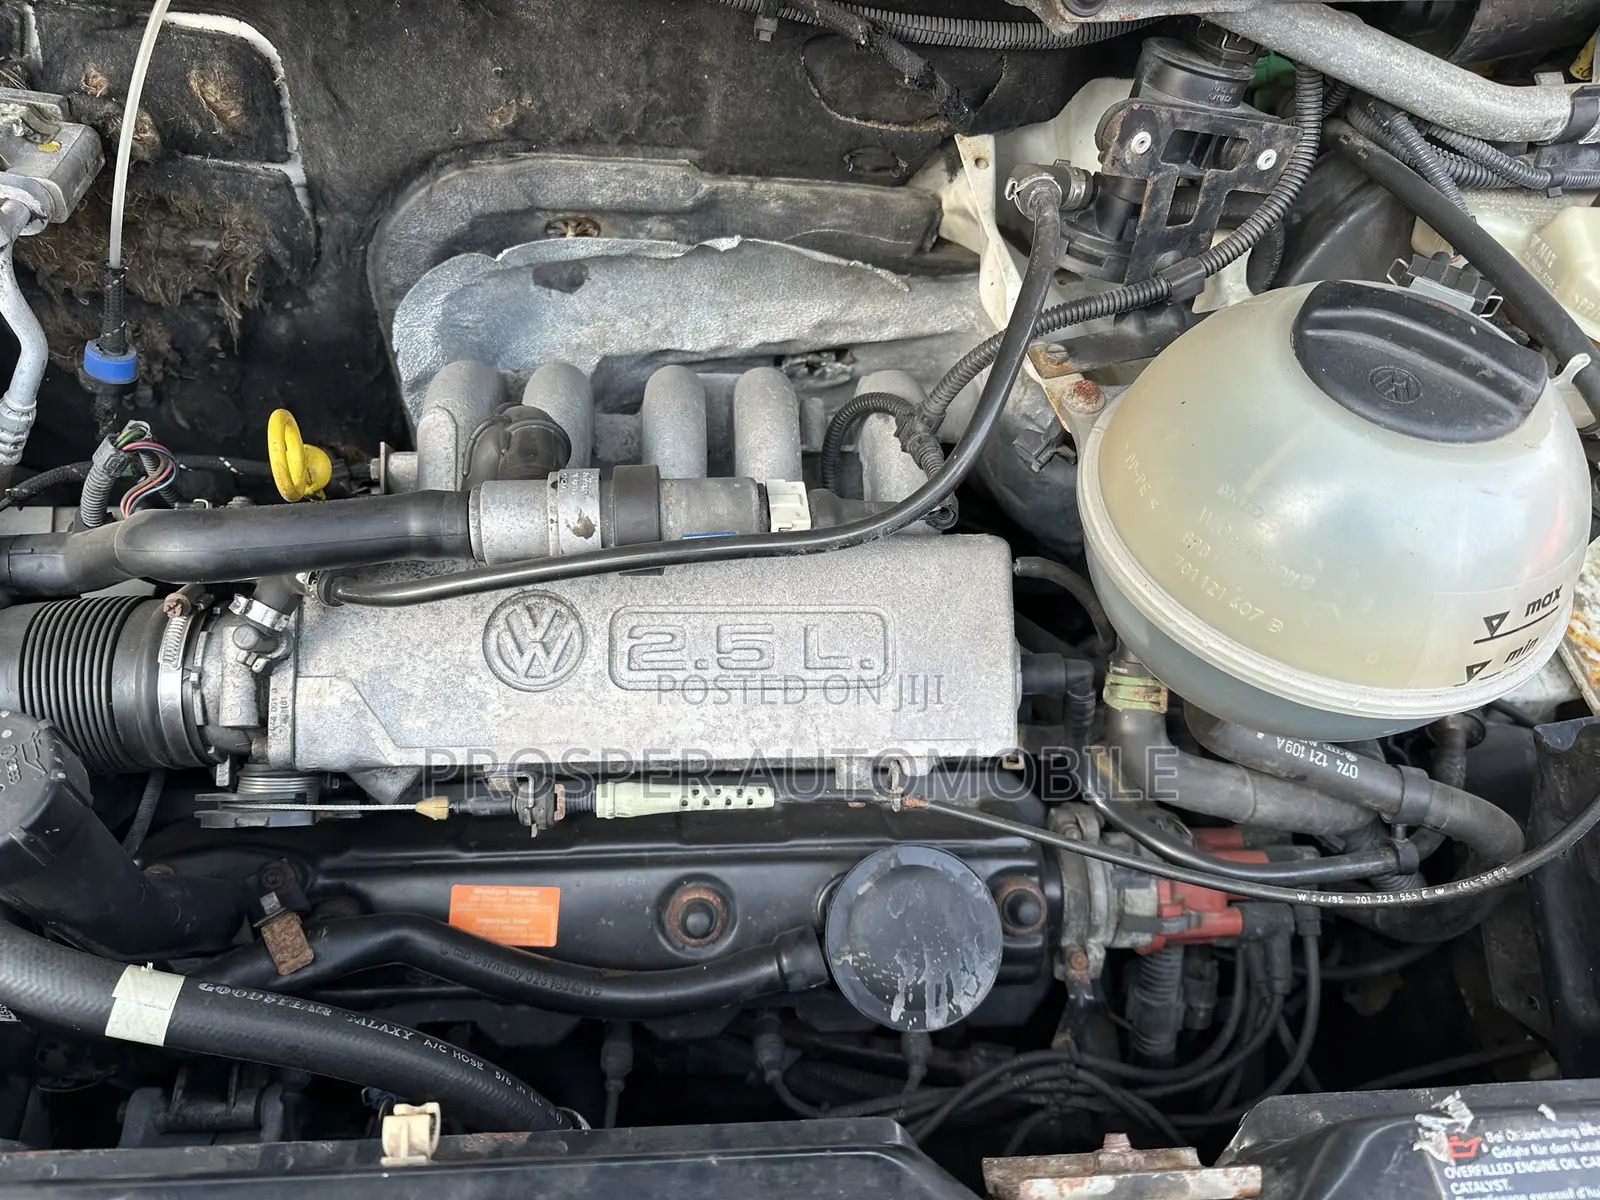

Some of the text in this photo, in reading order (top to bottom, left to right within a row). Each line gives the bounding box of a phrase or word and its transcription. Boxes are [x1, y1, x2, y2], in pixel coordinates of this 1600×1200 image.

[1202, 575, 1226, 601] 121
[1524, 584, 1563, 618] max
[628, 623, 875, 671] 2.5 L.
[1503, 637, 1539, 664] min
[1309, 749, 1328, 767] 121
[1336, 758, 1358, 779] 074
[1355, 895, 1371, 904] 701
[1376, 894, 1394, 904] 723
[1400, 892, 1418, 901] 555
[423, 1038, 447, 1054] A/C
[453, 1050, 484, 1071] HOSE
[1491, 1144, 1530, 1159] Gefahr
[1549, 1142, 1571, 1155] den
[1444, 1162, 1515, 1179] OVERFILLED
[1514, 1158, 1560, 1175] ENGINE
[1559, 1157, 1582, 1171] OIL
[1450, 1178, 1514, 1195] CATALYST.
